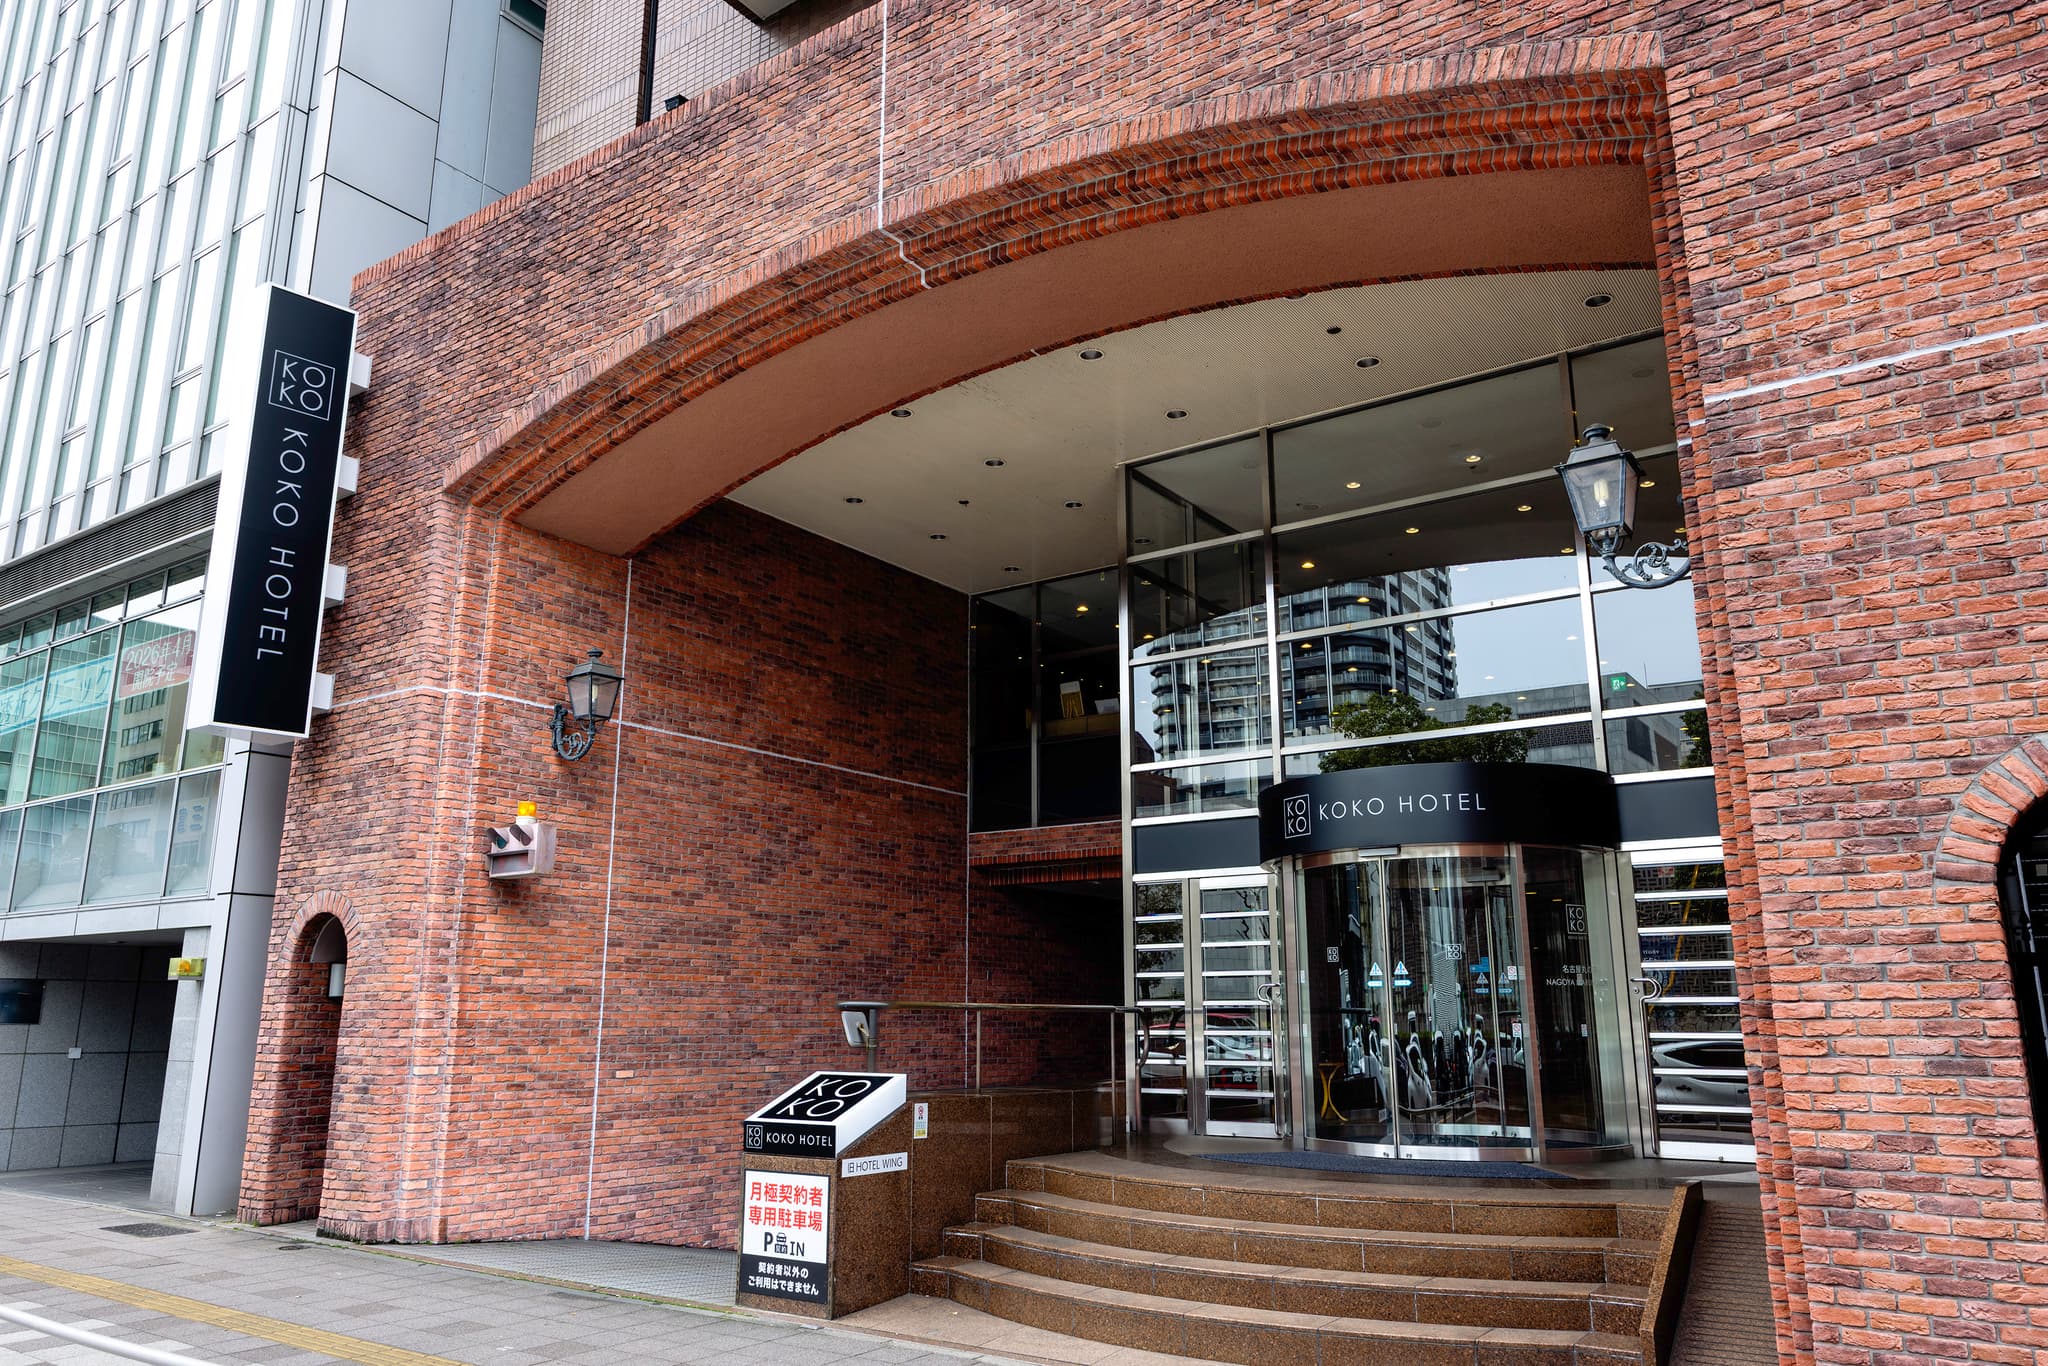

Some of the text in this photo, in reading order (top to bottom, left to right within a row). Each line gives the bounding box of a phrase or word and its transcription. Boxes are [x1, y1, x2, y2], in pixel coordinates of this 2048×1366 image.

[282, 358, 326, 388] KO
[279, 381, 323, 411] KO
[256, 427, 309, 661] KOKO HOTEL
[1287, 799, 1306, 817] KO
[1319, 792, 1486, 821] KOKO HOTEL
[1288, 816, 1307, 834] KO
[1569, 907, 1584, 919] KO
[1570, 920, 1585, 931] KO
[1546, 978, 1575, 986] NAGOYA
[805, 1078, 872, 1098] KO
[776, 1097, 845, 1117] KO
[749, 1127, 761, 1136] KO
[766, 1132, 833, 1147] KOKO HOTEL
[749, 1137, 761, 1147] KO
[882, 1156, 903, 1169] WING
[750, 1181, 823, 1208] 月極契約者
[748, 1205, 823, 1232] 専用駐車場
[763, 1231, 774, 1252] P
[789, 1241, 805, 1257] IN
[758, 1261, 809, 1279] 契約者以外の
[748, 1275, 819, 1296] ご利用はできません
